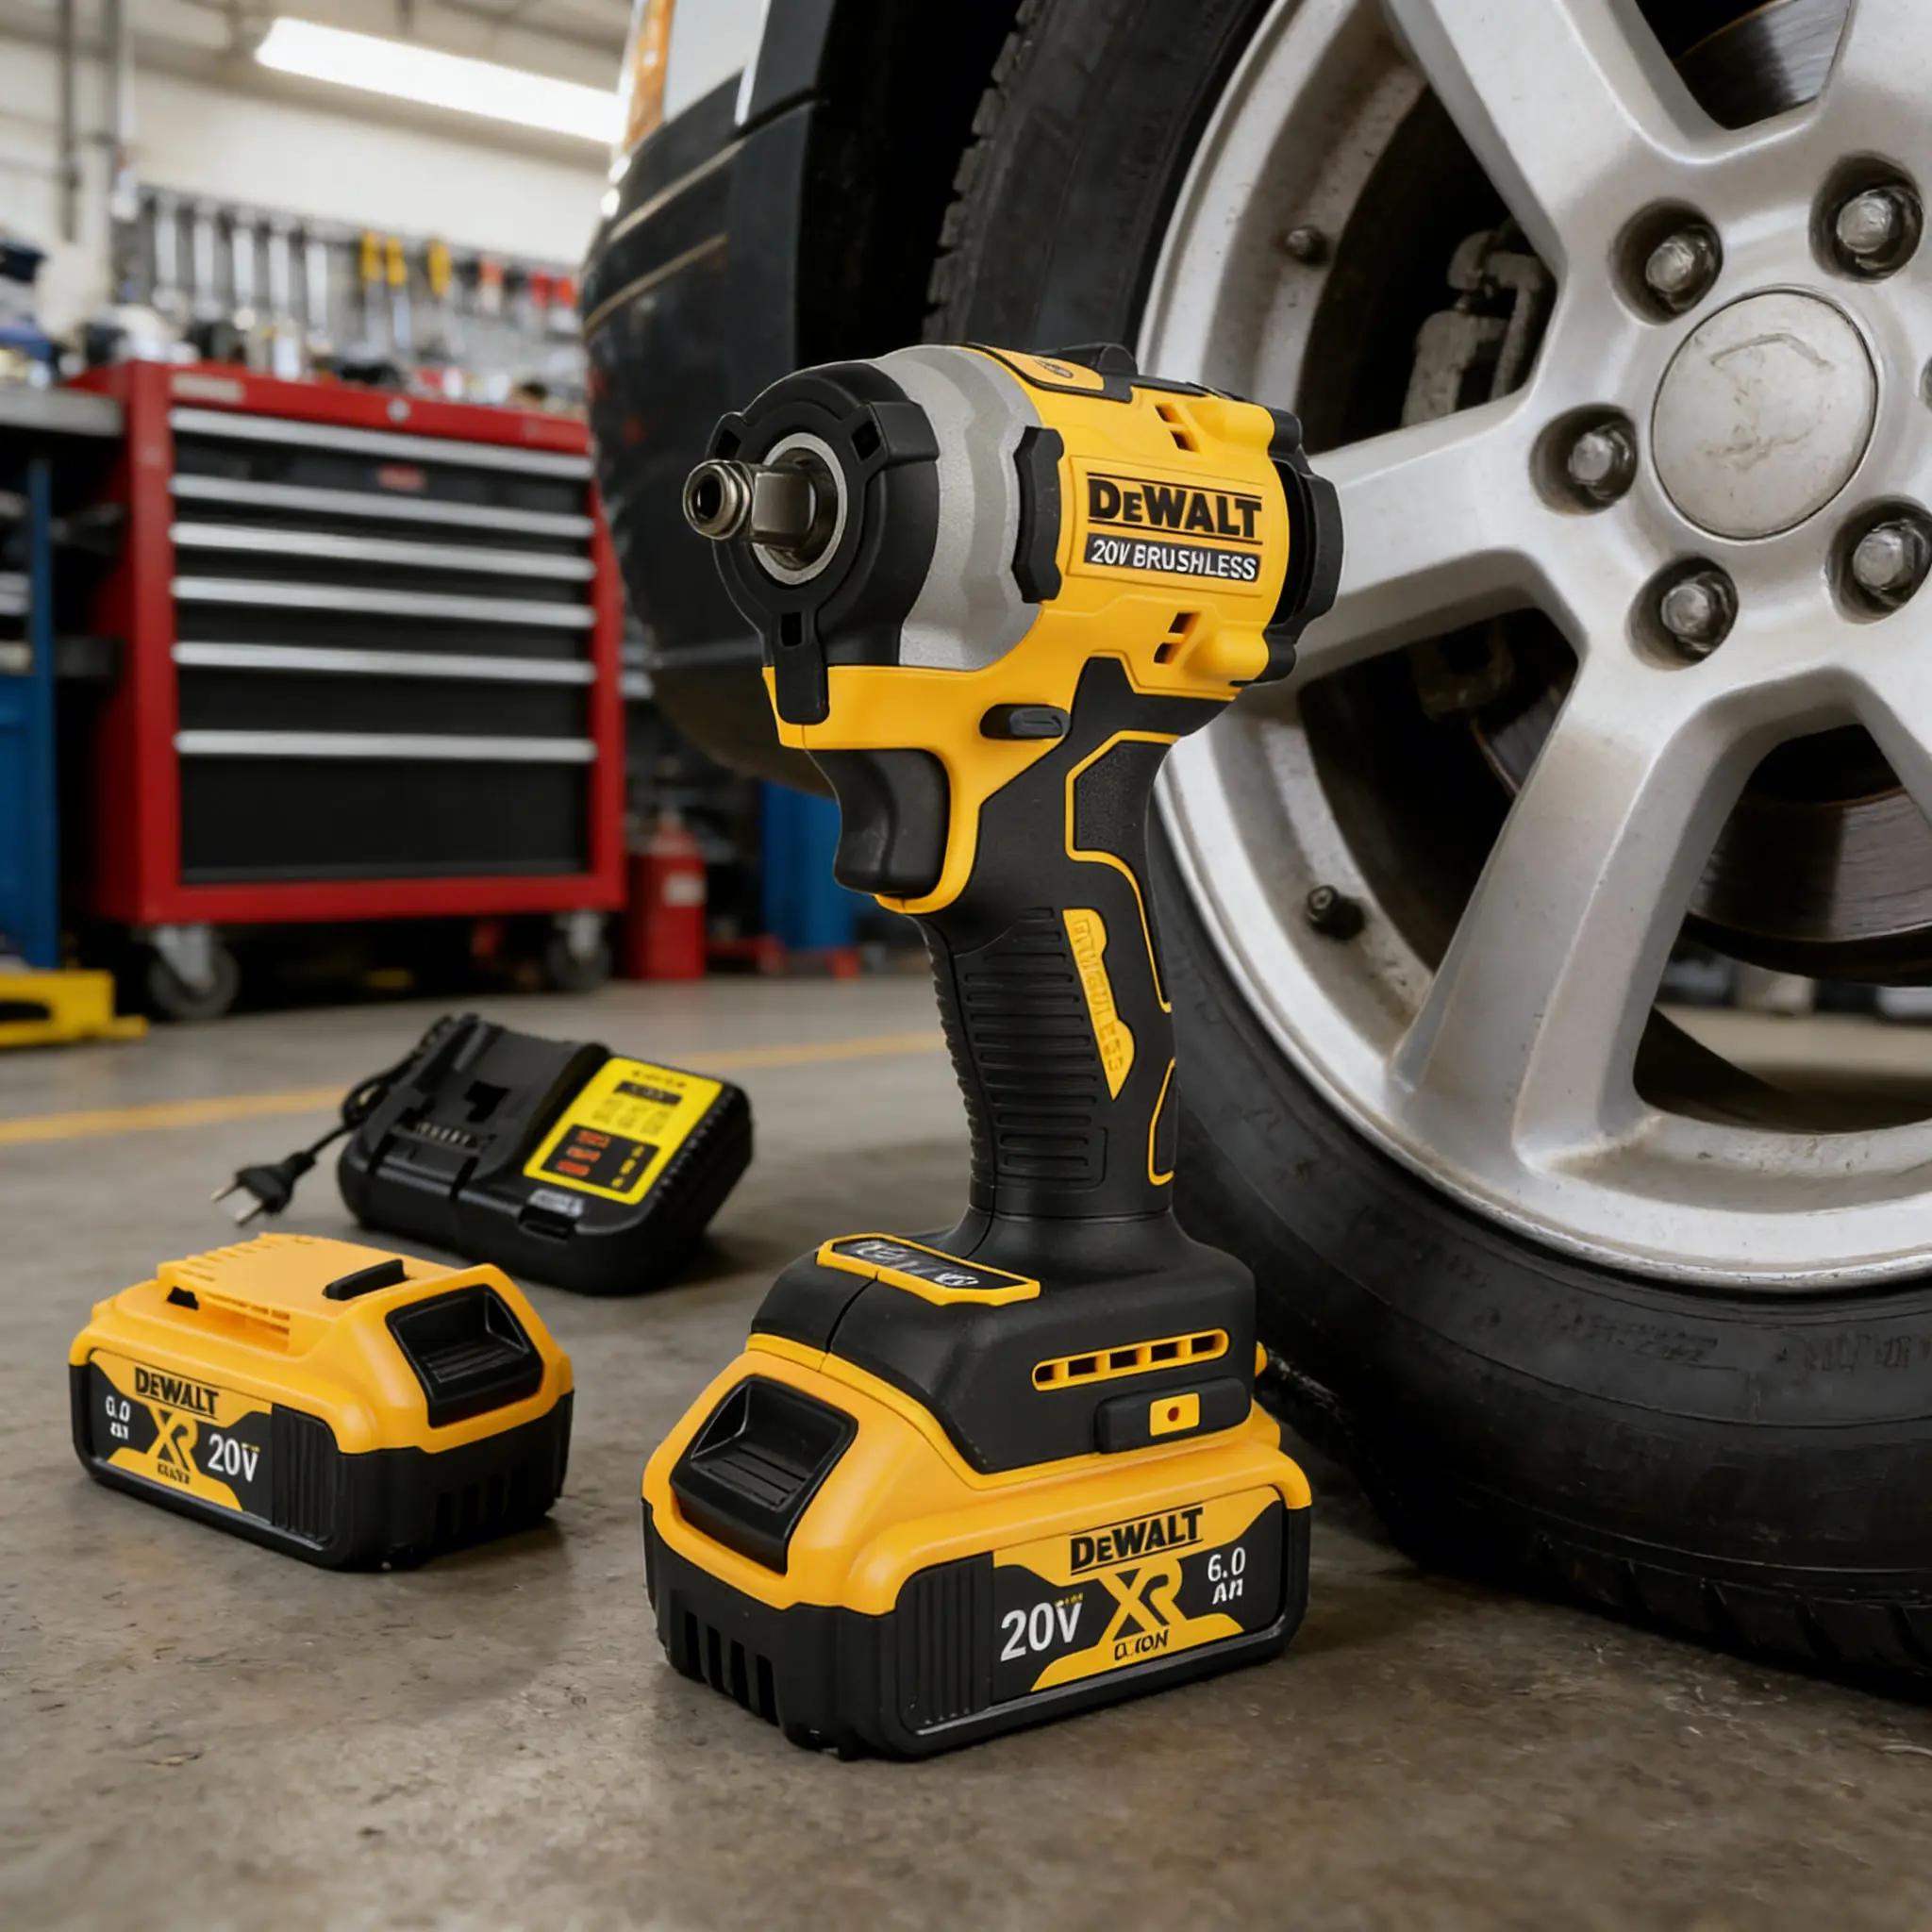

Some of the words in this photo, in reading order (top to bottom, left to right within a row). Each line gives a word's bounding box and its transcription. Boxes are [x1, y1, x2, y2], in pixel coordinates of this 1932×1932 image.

[1091, 540, 1129, 564] 20V
[1133, 545, 1257, 580] BRUSHLESS
[208, 1433, 258, 1482] 20V
[1208, 1547, 1245, 1581] 6.0
[1001, 1601, 1082, 1661] 20V
